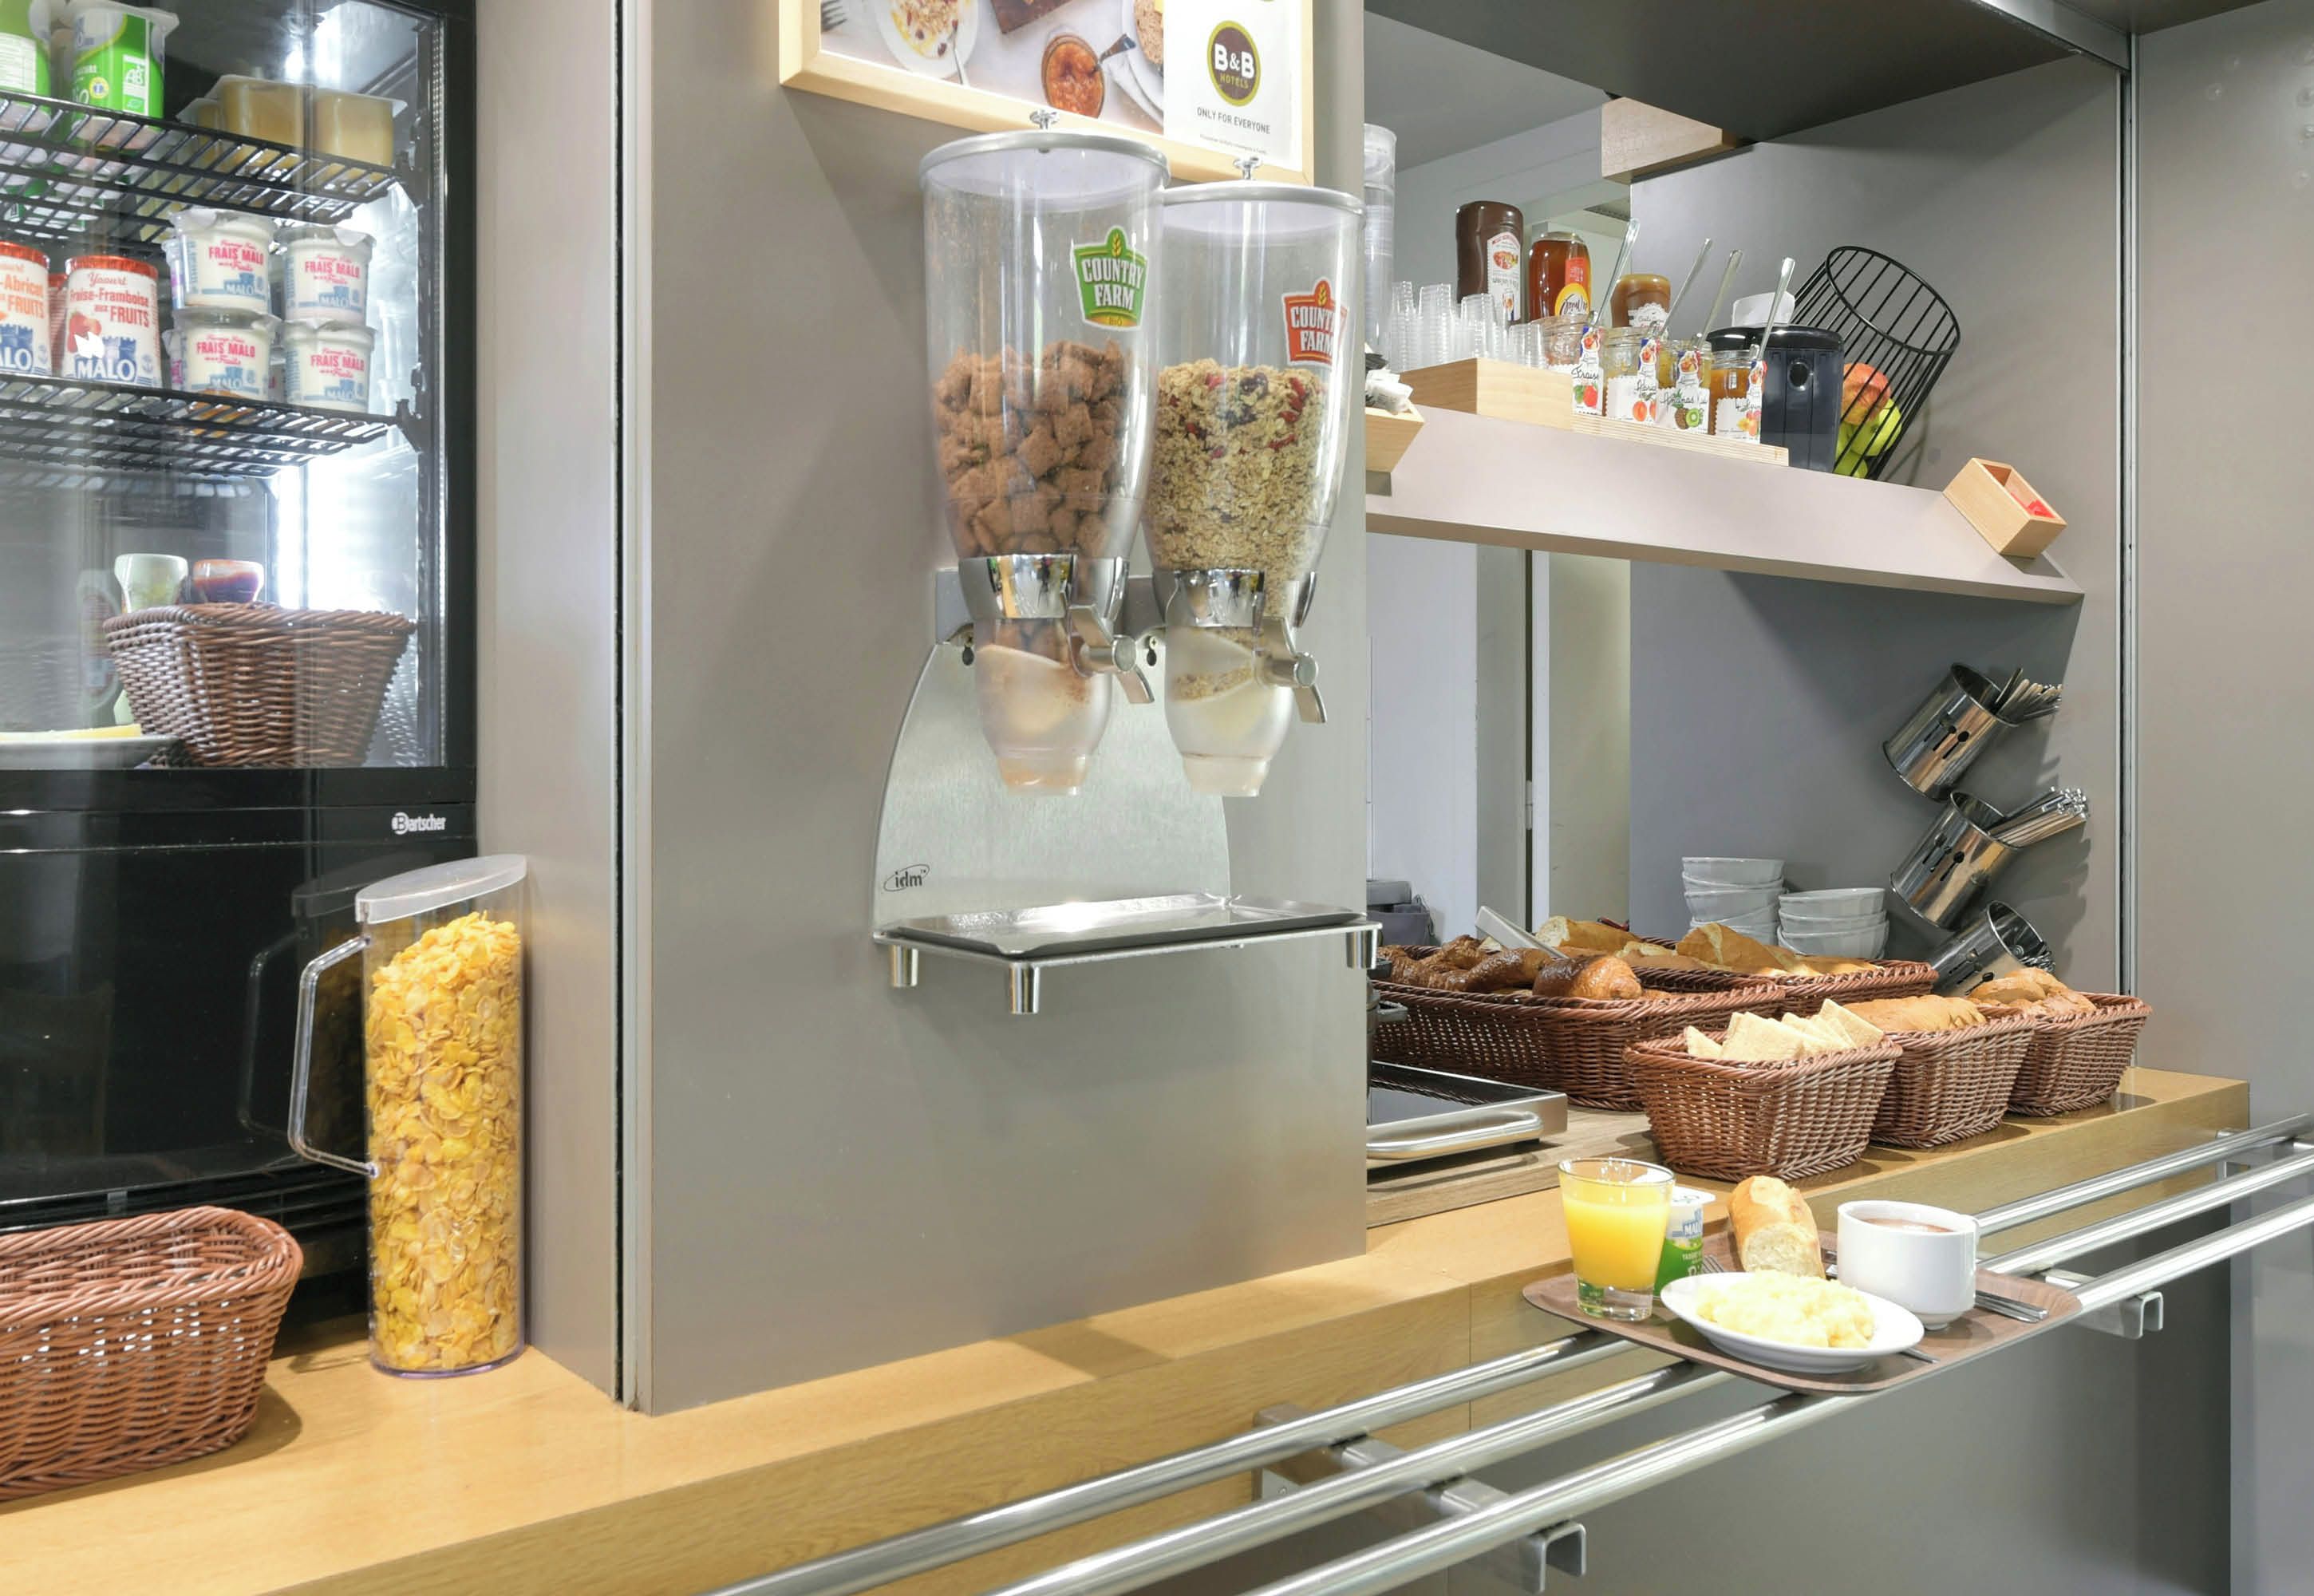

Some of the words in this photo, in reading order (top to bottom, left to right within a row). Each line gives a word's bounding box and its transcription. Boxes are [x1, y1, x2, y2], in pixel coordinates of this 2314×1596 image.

[1214, 43, 1255, 79] B&B
[1220, 73, 1249, 89] HOTELS
[1197, 106, 1216, 120] ONLY
[1218, 112, 1232, 124] FOR
[1234, 117, 1271, 135] EVERYONE
[208, 246, 239, 260] FRAIS
[1081, 257, 1144, 289] COUNTRY
[8, 294, 45, 319] FRUITS
[1094, 282, 1135, 310] FARM
[110, 305, 151, 328] FRUITS
[195, 342, 225, 355] FRAIS
[77, 358, 136, 382] MALO
[391, 812, 447, 836] Bartscher
